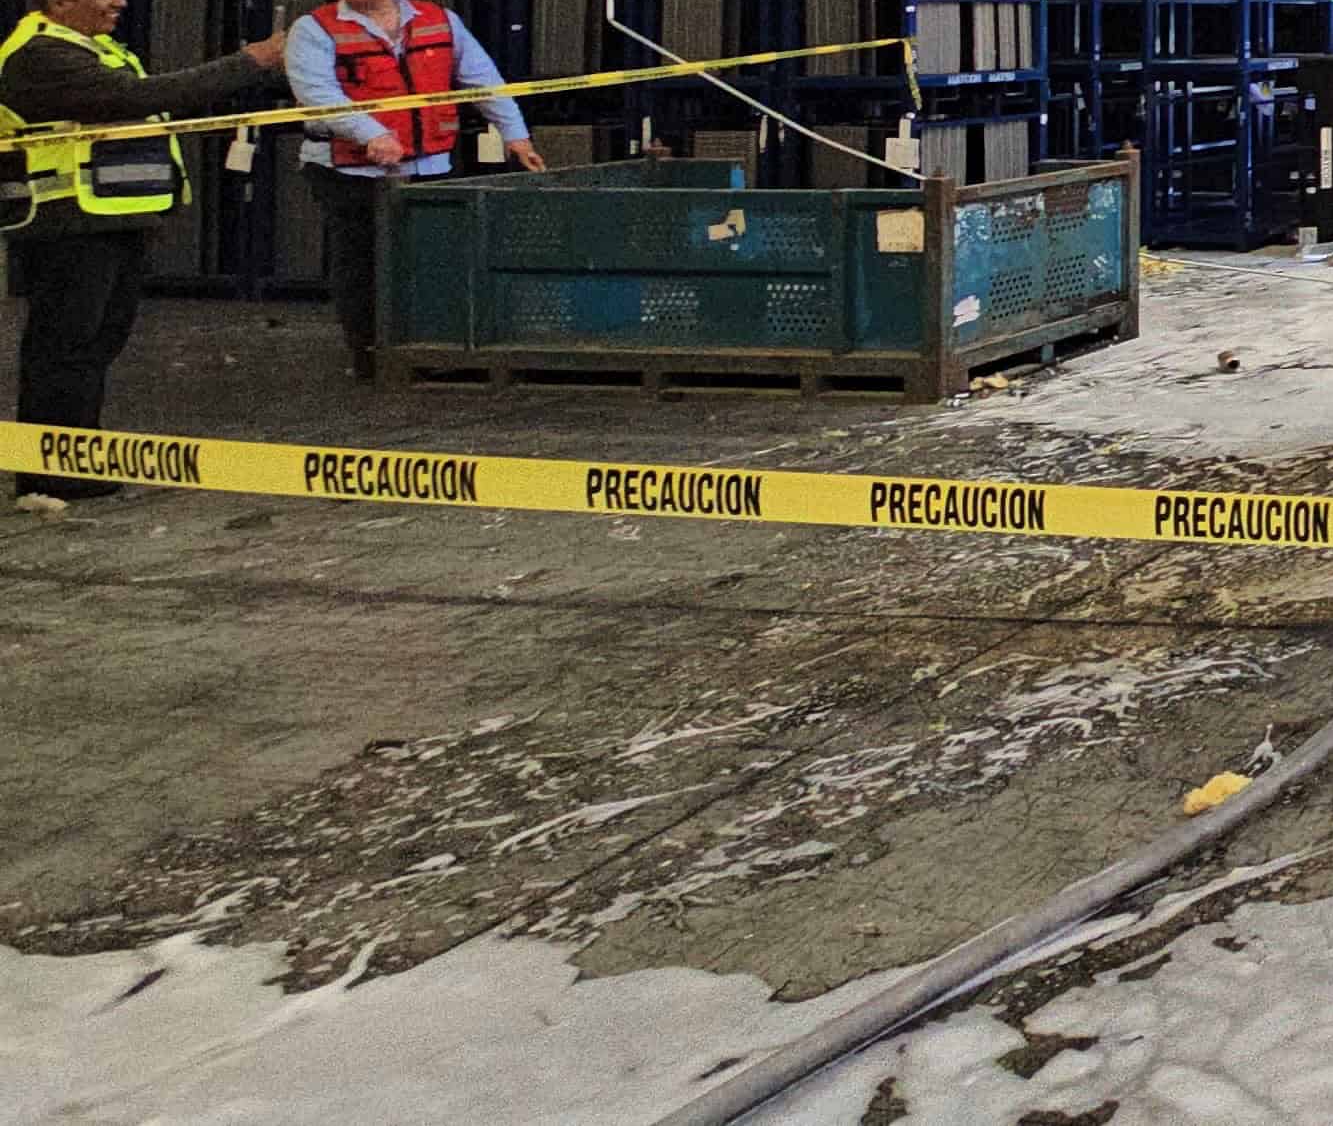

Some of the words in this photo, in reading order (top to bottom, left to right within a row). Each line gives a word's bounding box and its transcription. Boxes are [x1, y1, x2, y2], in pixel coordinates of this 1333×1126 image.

[40, 432, 200, 483] PRECAUCION
[304, 453, 477, 501] PRECAUCION
[587, 468, 761, 516] PRECAUCION
[871, 482, 1045, 530] PRECAUCION
[1156, 496, 1329, 542] PRECAUCION
